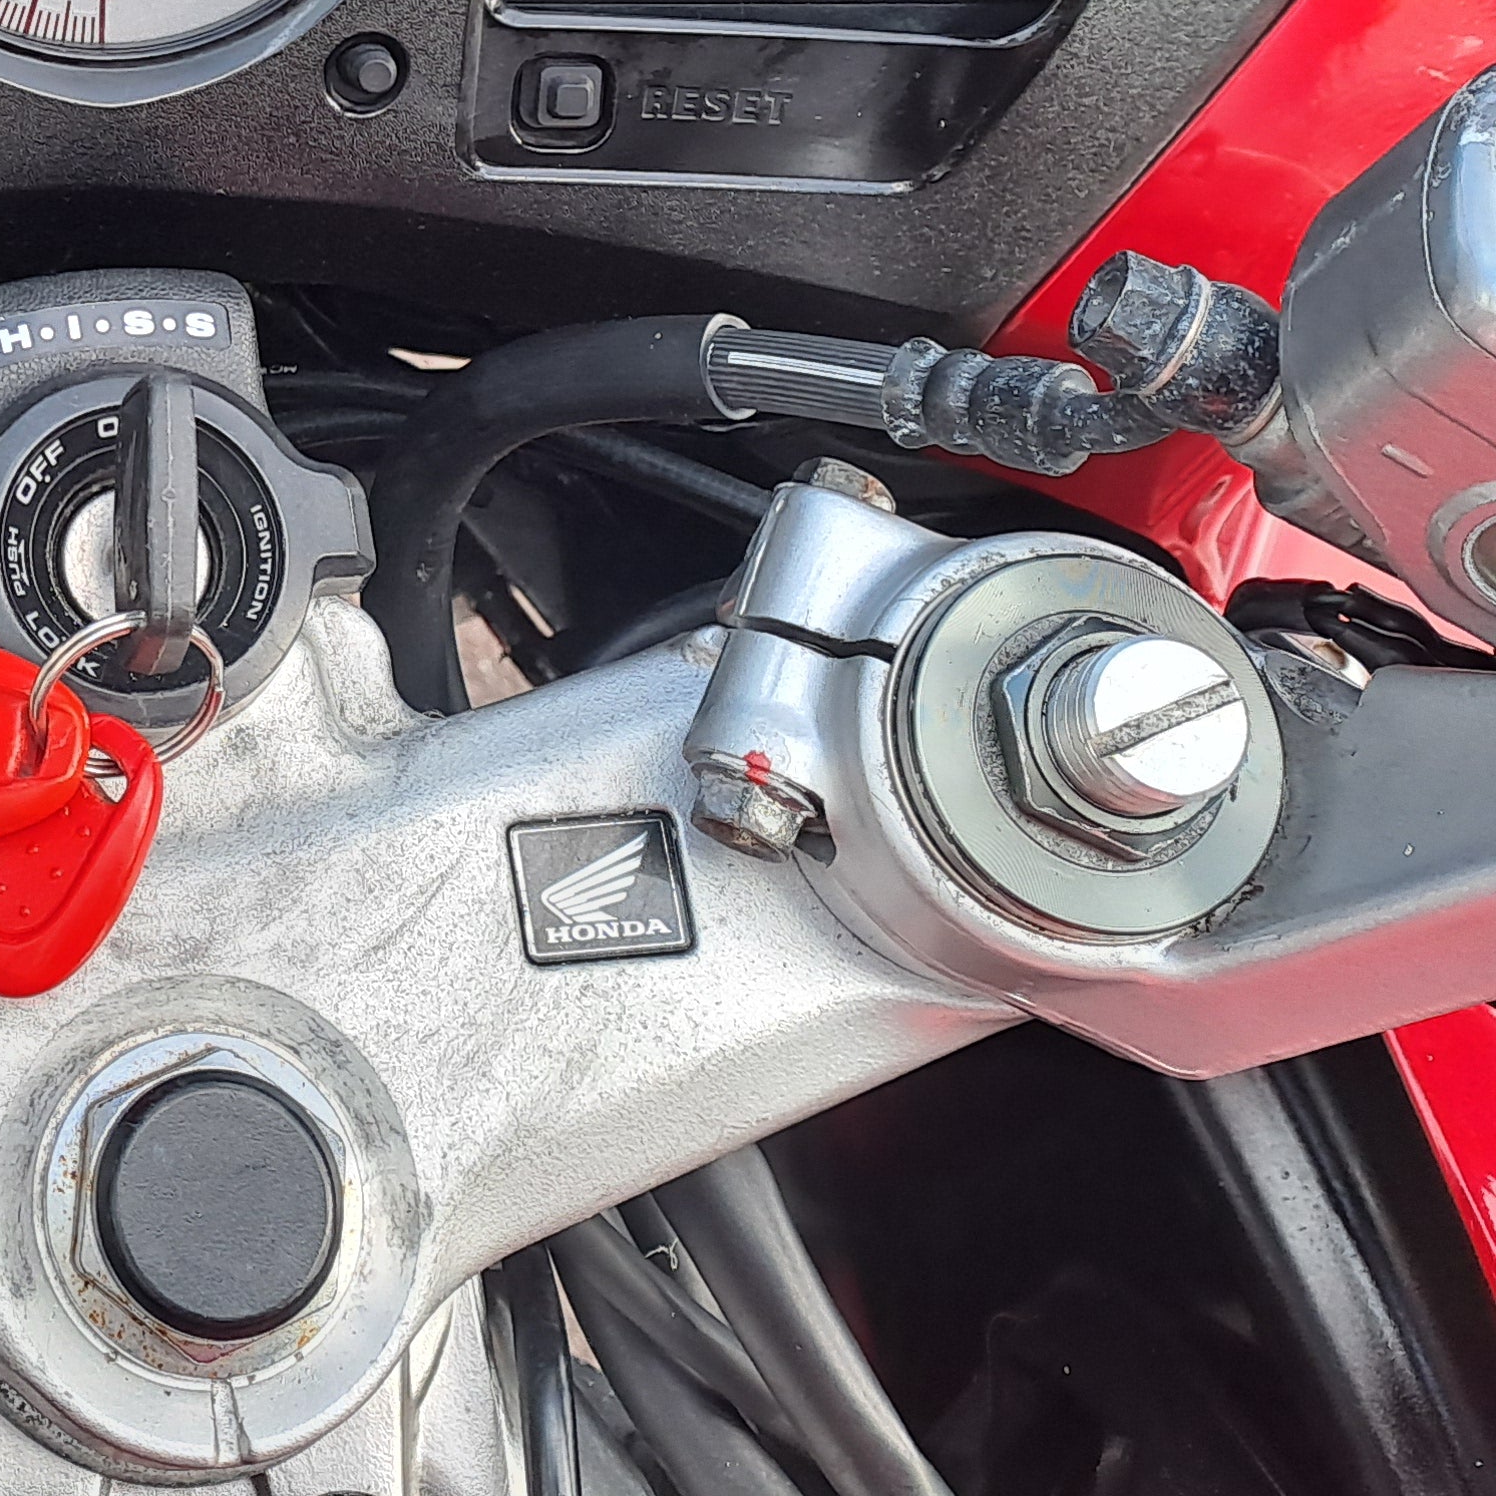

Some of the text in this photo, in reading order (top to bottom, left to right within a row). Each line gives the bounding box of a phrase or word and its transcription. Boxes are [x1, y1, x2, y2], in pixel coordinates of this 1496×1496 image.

[639, 84, 794, 125] RESET
[15, 439, 65, 504] OFF
[8, 526, 26, 597] PUSH
[245, 504, 274, 621] IGNITION
[24, 610, 102, 679] LOK
[544, 917, 673, 944] HONDA
